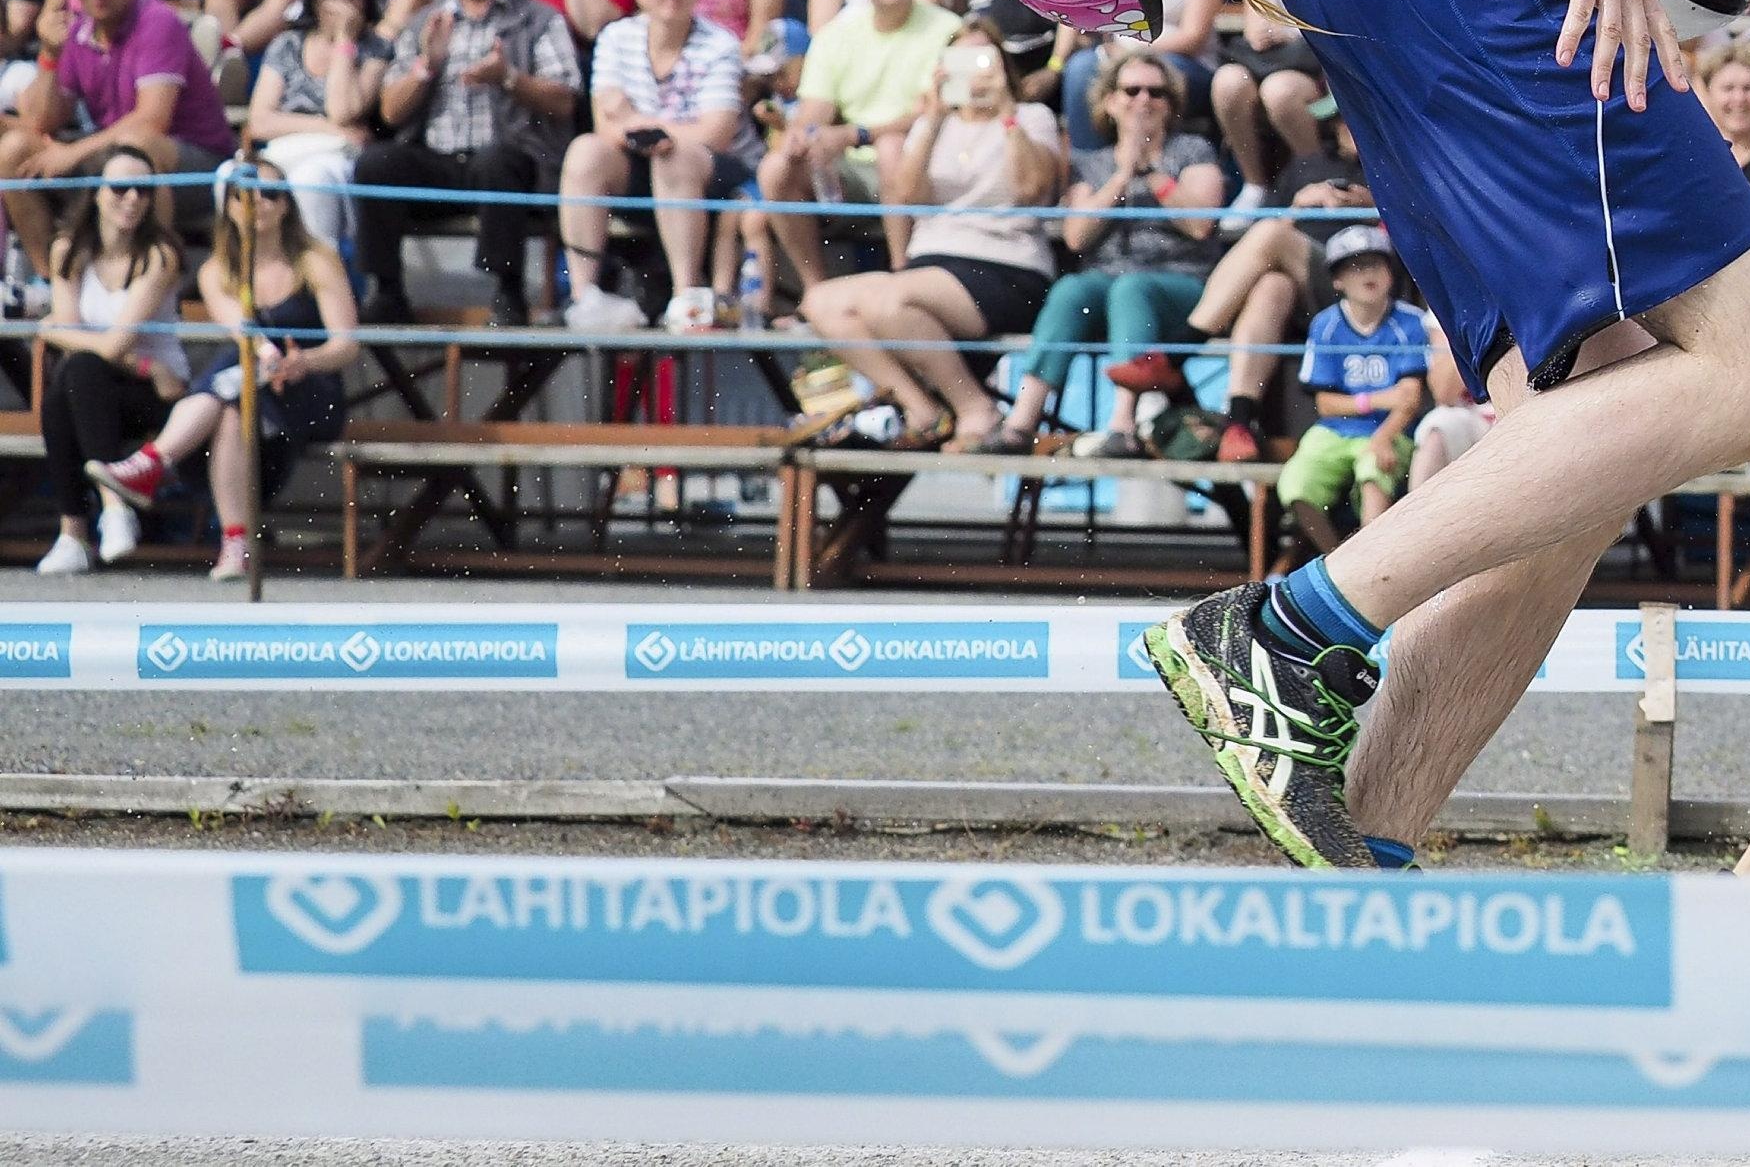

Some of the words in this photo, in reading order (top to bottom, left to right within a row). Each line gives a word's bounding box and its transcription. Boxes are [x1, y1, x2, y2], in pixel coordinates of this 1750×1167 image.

[1343, 354, 1391, 389] 20
[190, 637, 336, 662] LÄHITAPIOLA
[384, 638, 548, 662] LOKALTAPIOLA
[680, 636, 826, 662] LÄHITAPIOLA
[874, 638, 1040, 662] LOKALTAPIOLA
[1080, 881, 1636, 956] LOKALTAPIOLA
